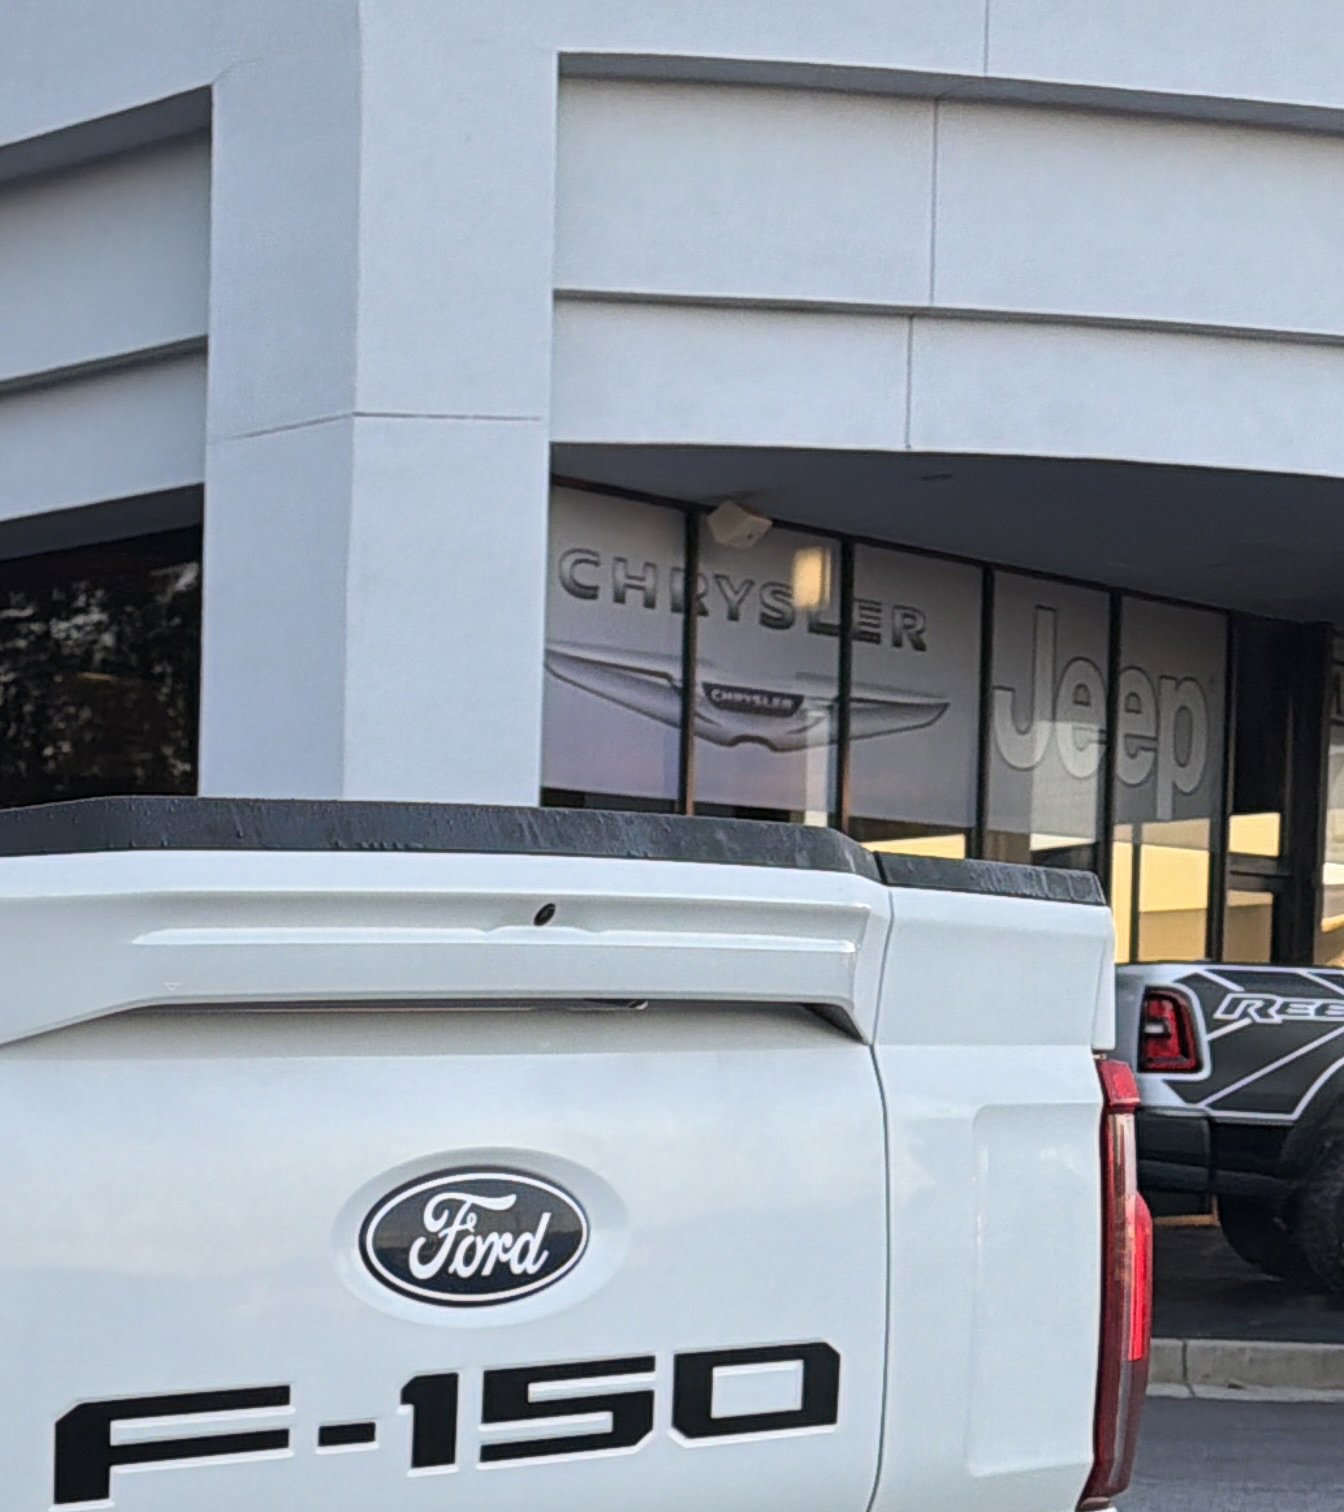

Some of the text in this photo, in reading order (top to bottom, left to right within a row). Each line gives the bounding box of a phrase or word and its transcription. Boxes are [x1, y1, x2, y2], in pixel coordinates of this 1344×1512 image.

[558, 548, 928, 652] CHRYSLER
[992, 604, 1209, 820] Jeep
[408, 1191, 555, 1280] Ford
[53, 1341, 841, 1507] F-150
